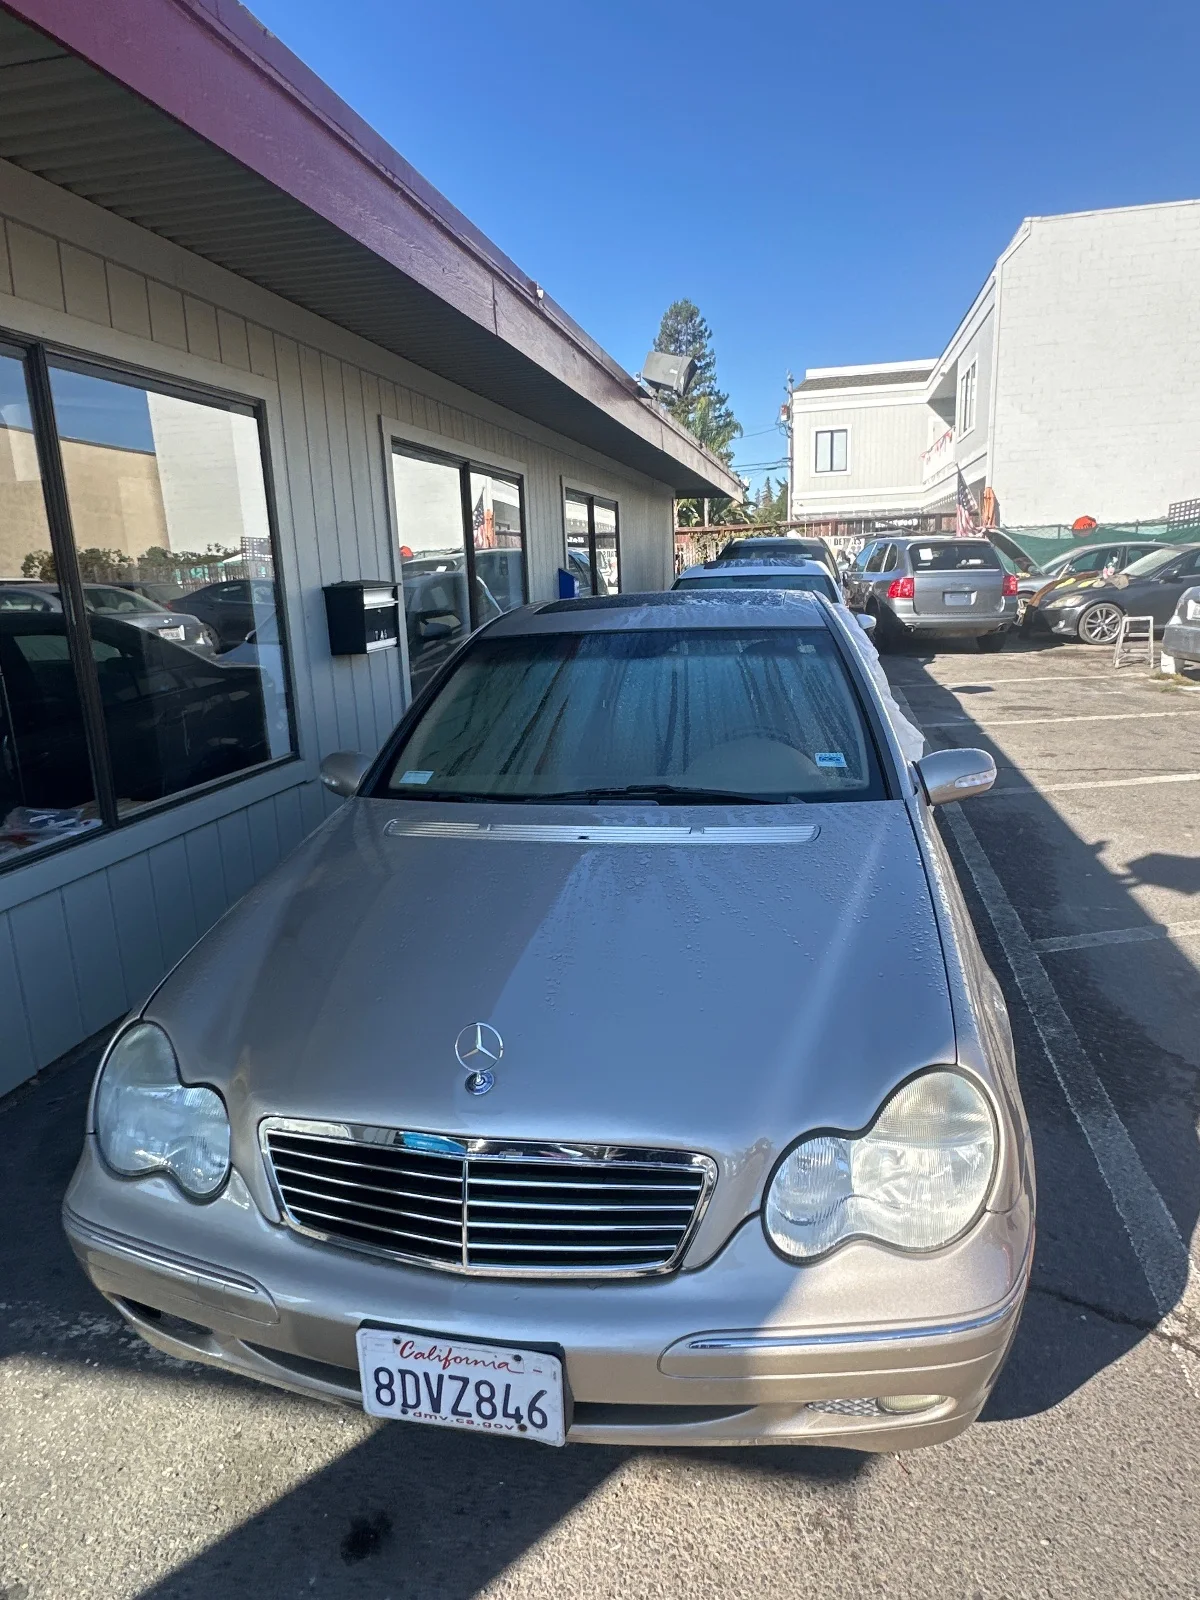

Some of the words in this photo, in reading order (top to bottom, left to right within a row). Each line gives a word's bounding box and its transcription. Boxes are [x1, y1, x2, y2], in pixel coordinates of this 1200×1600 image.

[399, 1340, 525, 1374] California
[373, 1366, 549, 1430] 8DVZ846
[412, 1410, 514, 1431] dmv.ca.gov
